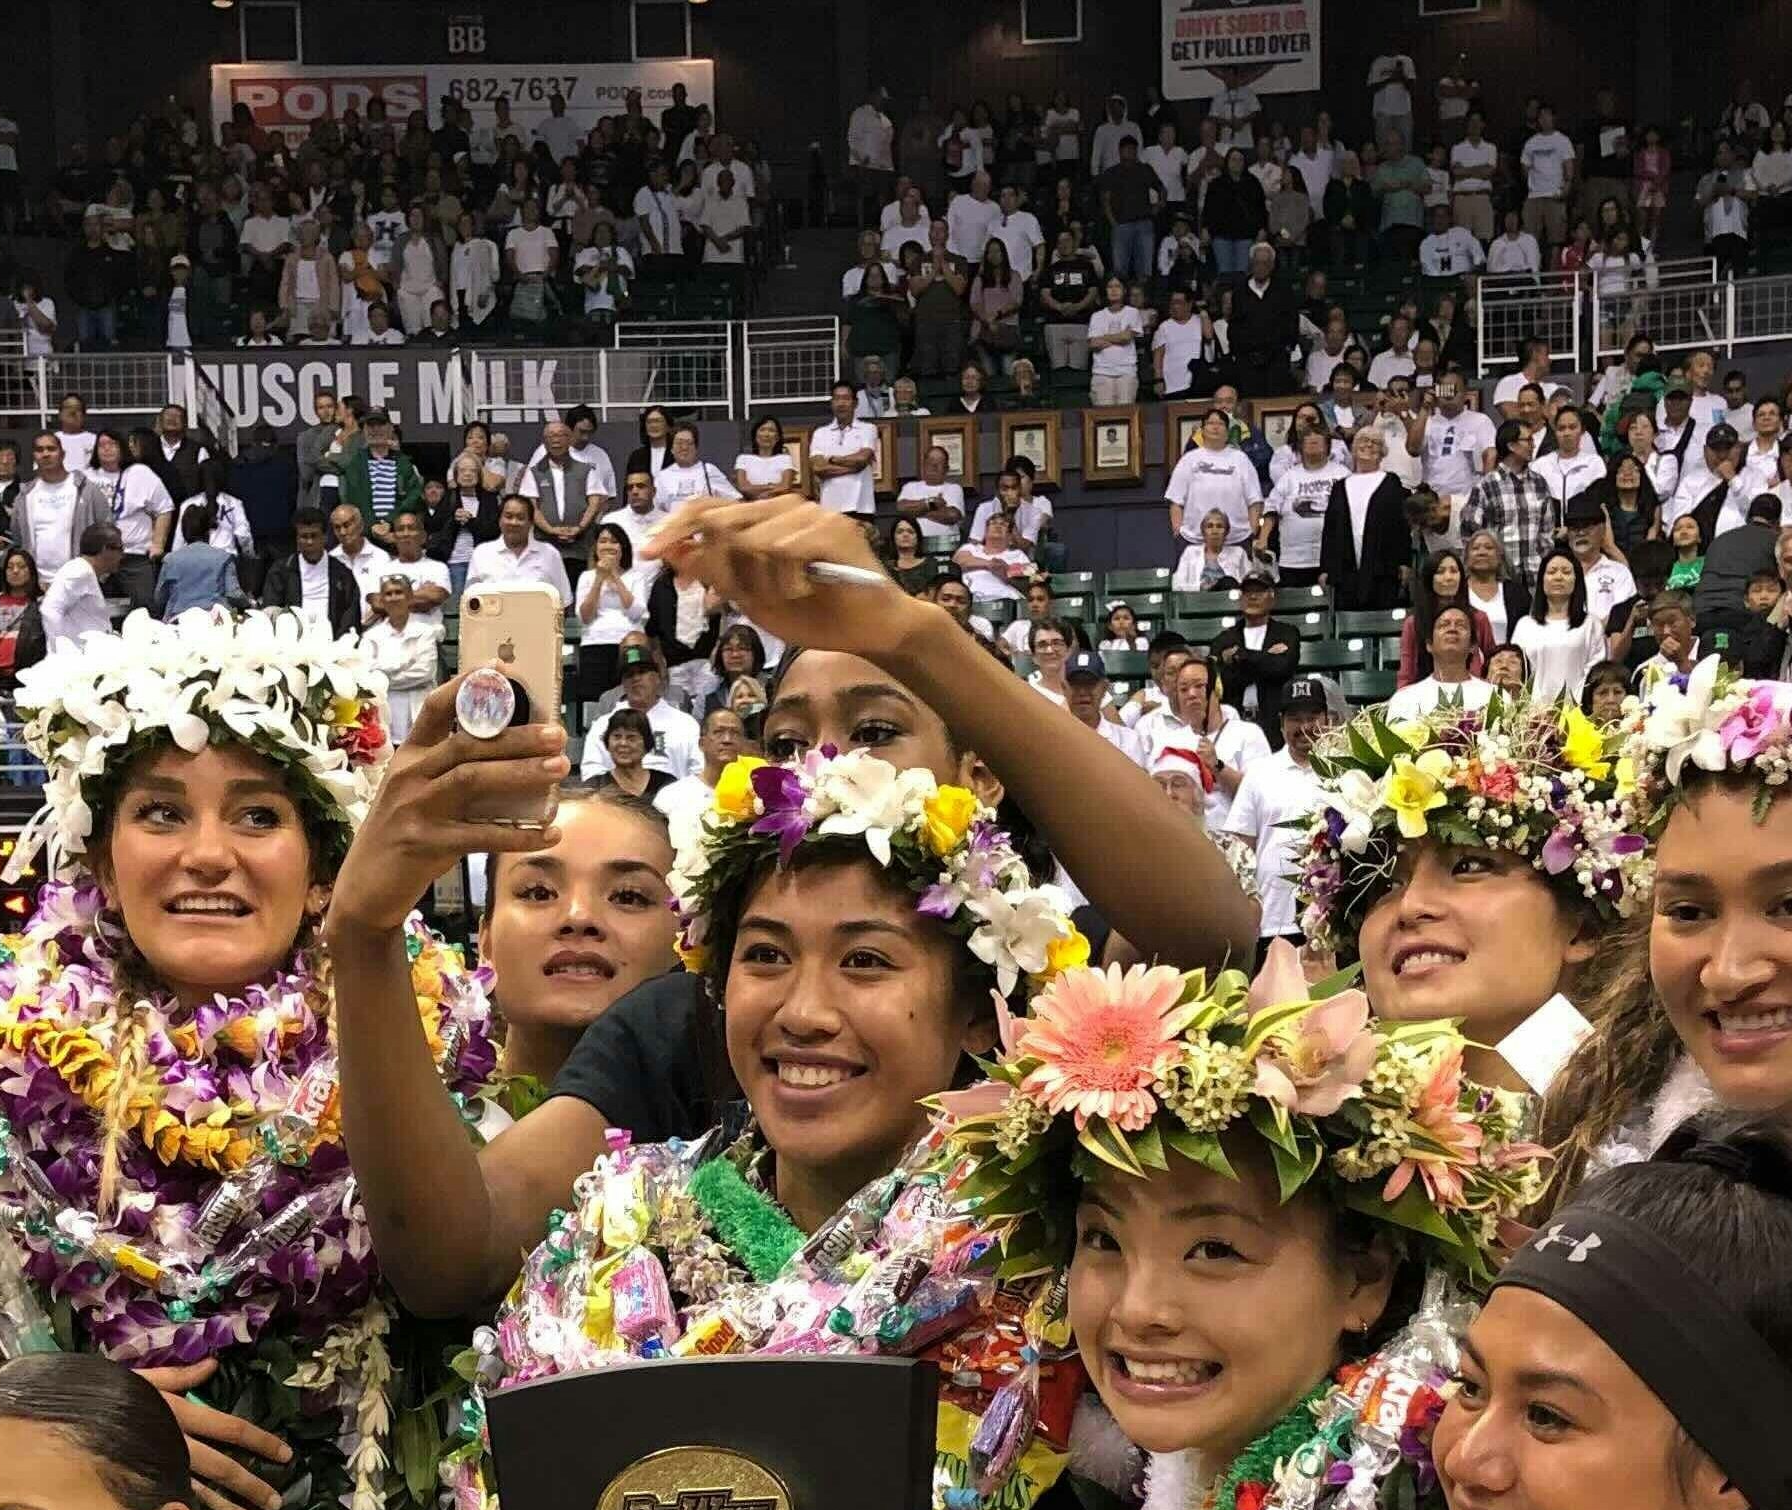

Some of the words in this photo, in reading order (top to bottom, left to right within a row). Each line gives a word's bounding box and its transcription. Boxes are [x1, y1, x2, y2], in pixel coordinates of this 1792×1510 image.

[1171, 41, 1201, 62] GET
[1205, 37, 1266, 59] PULLED
[1268, 32, 1312, 54] OVER
[448, 76, 578, 104] 682-7637
